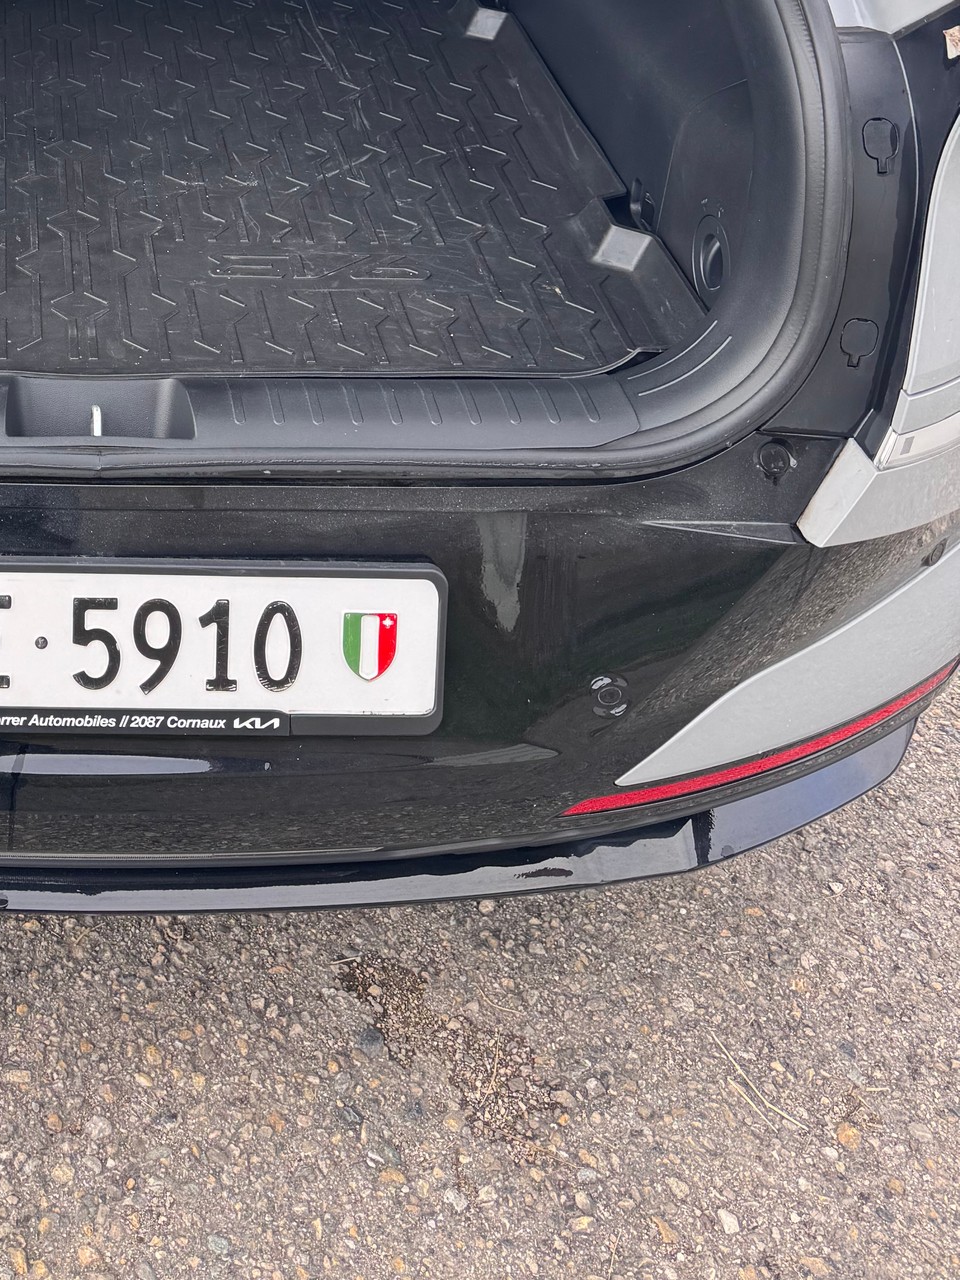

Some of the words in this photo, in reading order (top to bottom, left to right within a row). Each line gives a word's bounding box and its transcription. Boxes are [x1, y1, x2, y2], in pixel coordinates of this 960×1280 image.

[70, 596, 303, 695] 5910
[28, 713, 116, 728] Automobiles
[130, 715, 165, 728] 2087
[166, 716, 227, 729] Cornaux
[233, 717, 280, 730] KIA
